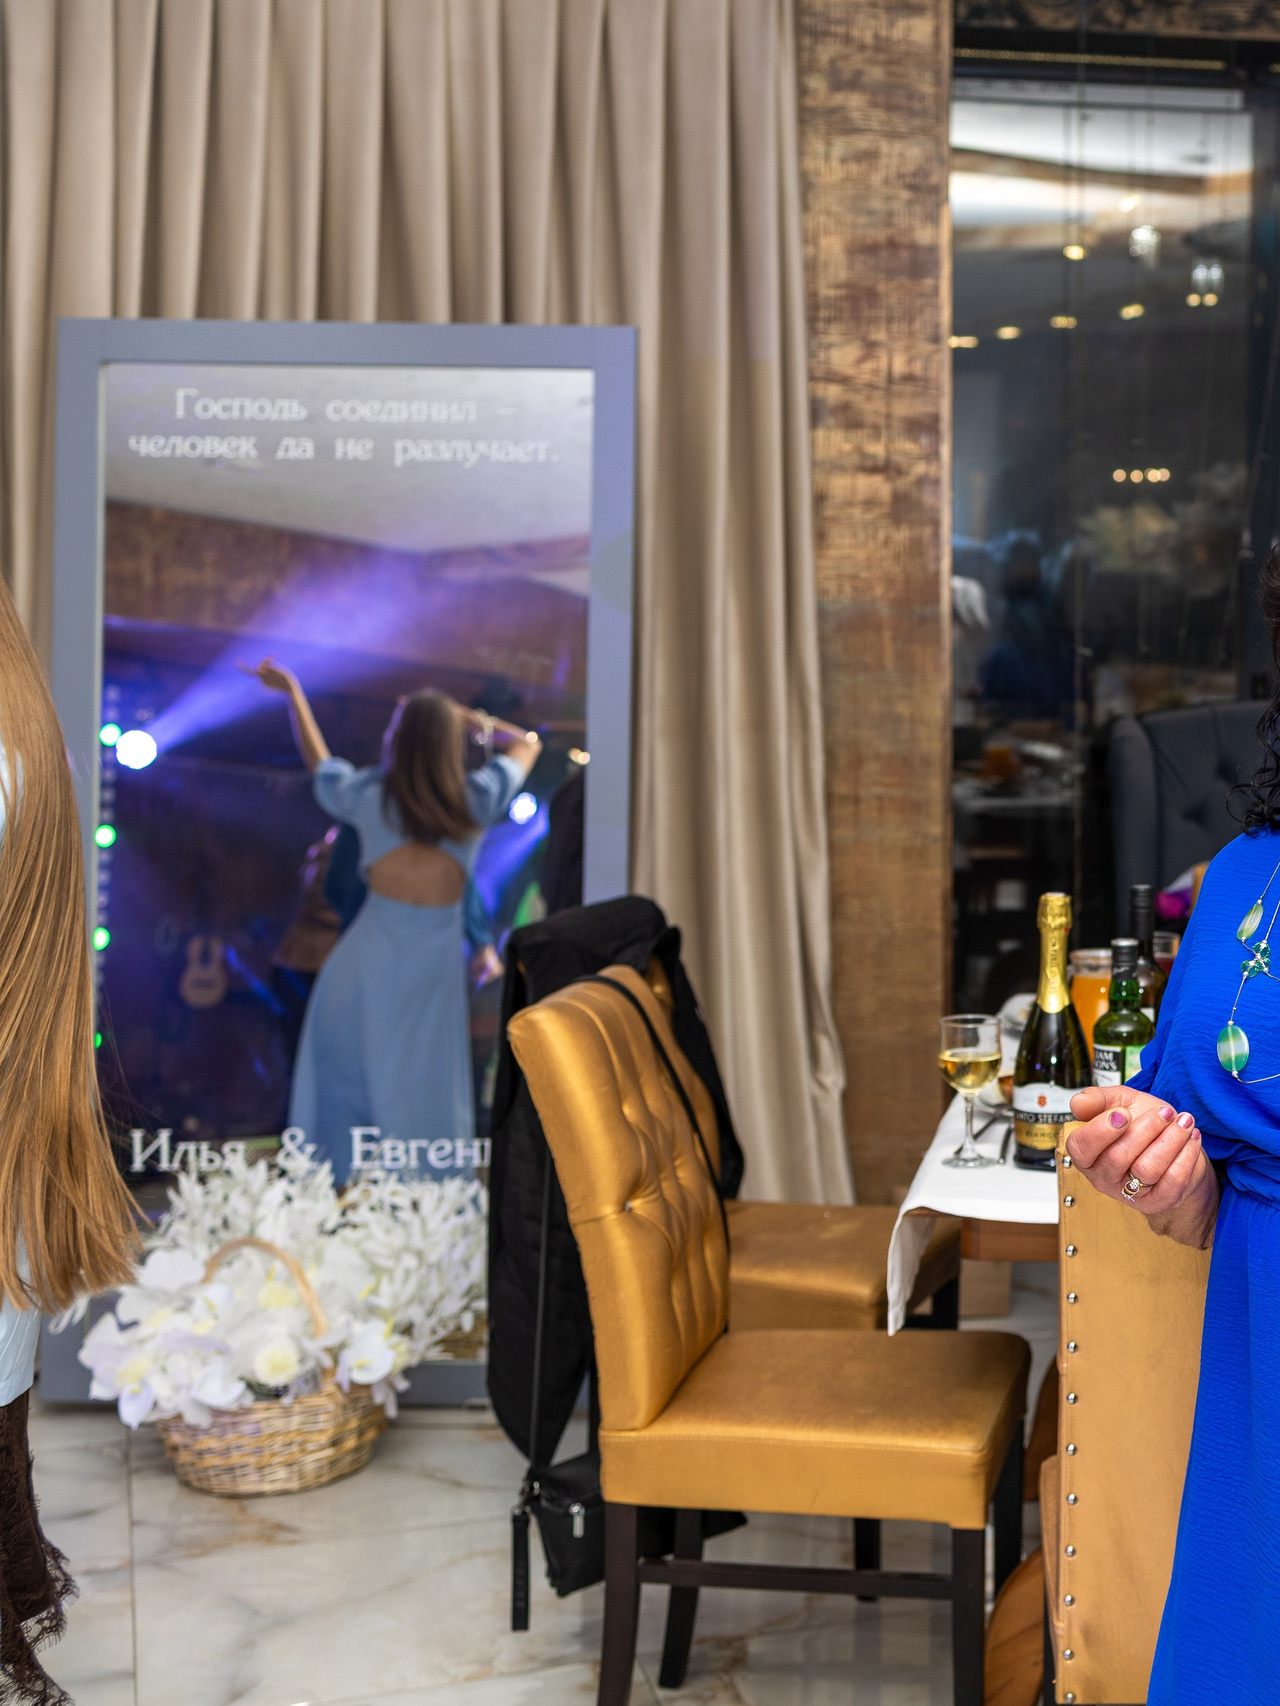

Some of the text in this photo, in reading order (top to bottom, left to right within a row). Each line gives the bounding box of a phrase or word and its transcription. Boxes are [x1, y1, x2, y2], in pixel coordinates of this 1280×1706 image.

[174, 387, 308, 424] Господь
[325, 399, 478, 424] соединил
[127, 433, 258, 459] человек
[275, 436, 314, 461] да
[334, 435, 374, 461] не
[1037, 1113, 1074, 1124] STEFAN
[130, 1126, 492, 1173] Илья & Евген
